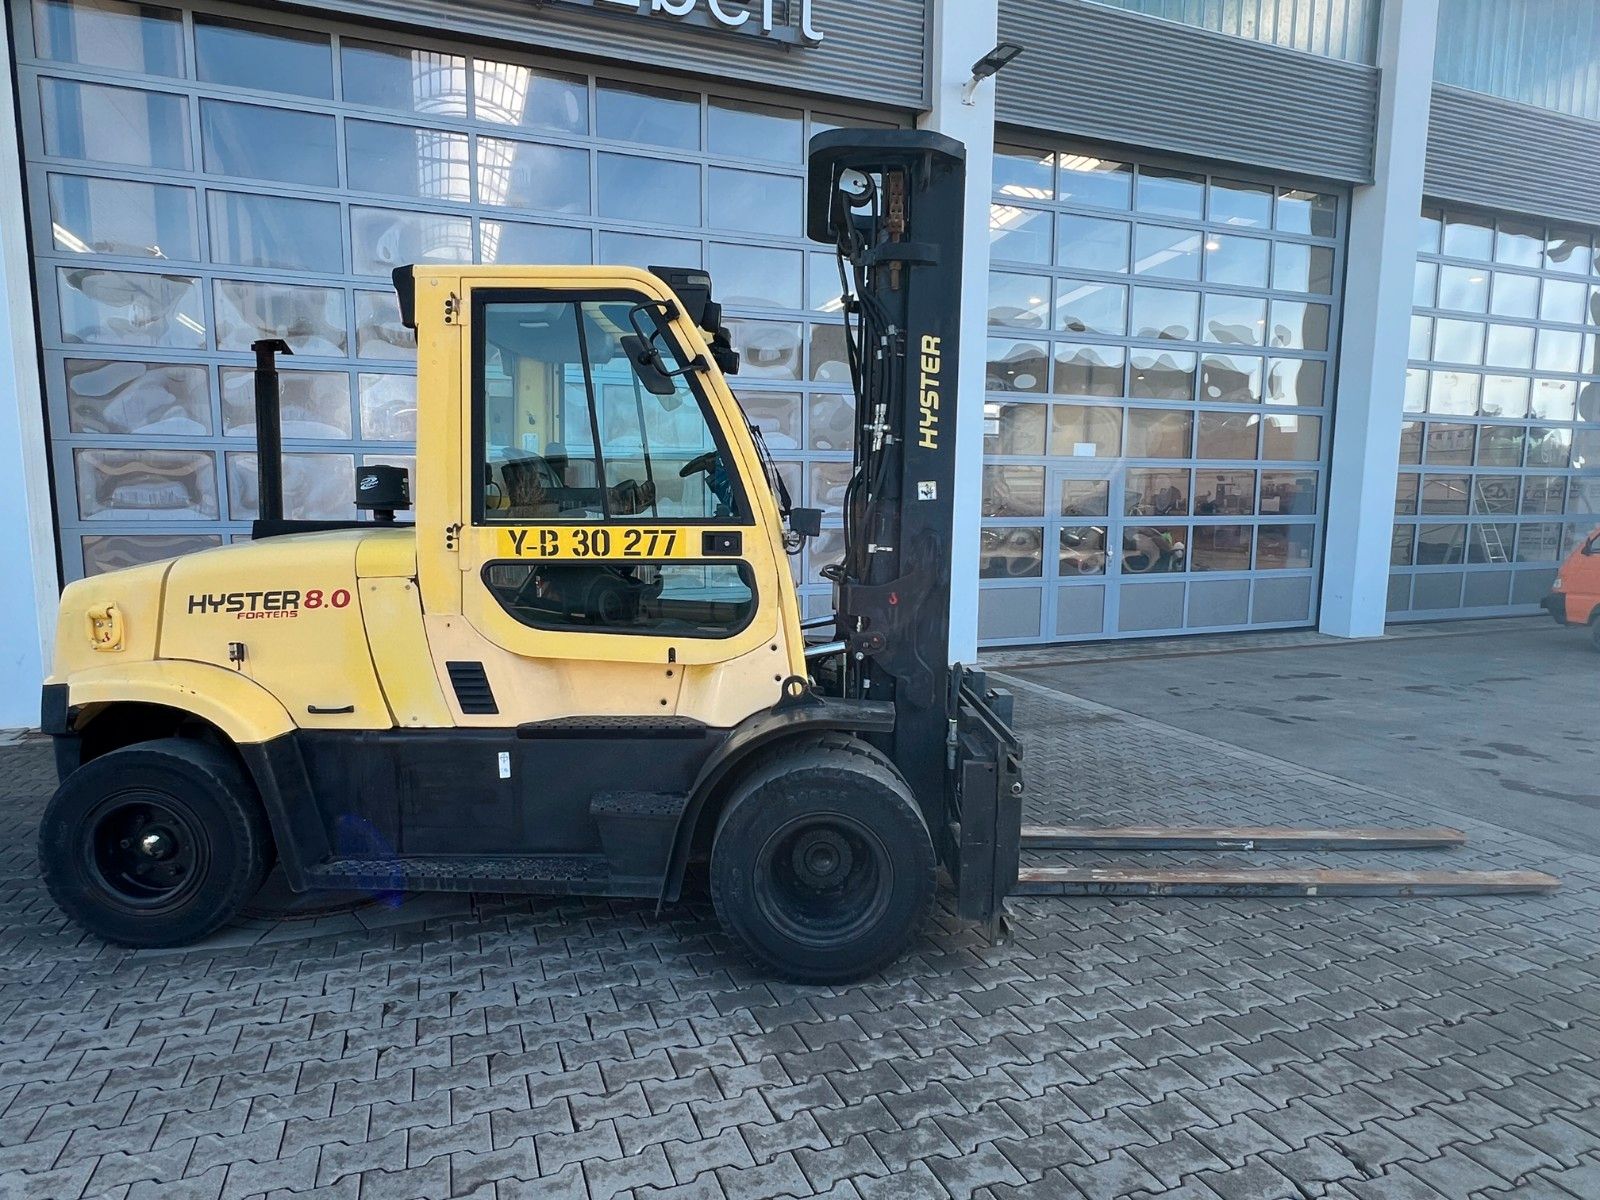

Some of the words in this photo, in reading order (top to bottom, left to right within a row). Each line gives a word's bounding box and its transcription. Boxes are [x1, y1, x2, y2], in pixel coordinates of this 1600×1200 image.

[918, 334, 941, 449] HYSTER
[508, 530, 559, 557] Y-B
[572, 529, 610, 557] 30
[623, 530, 677, 557] 277
[188, 590, 301, 614] HYSTER
[304, 589, 351, 609] 8.0
[237, 610, 298, 620] FORTENS
